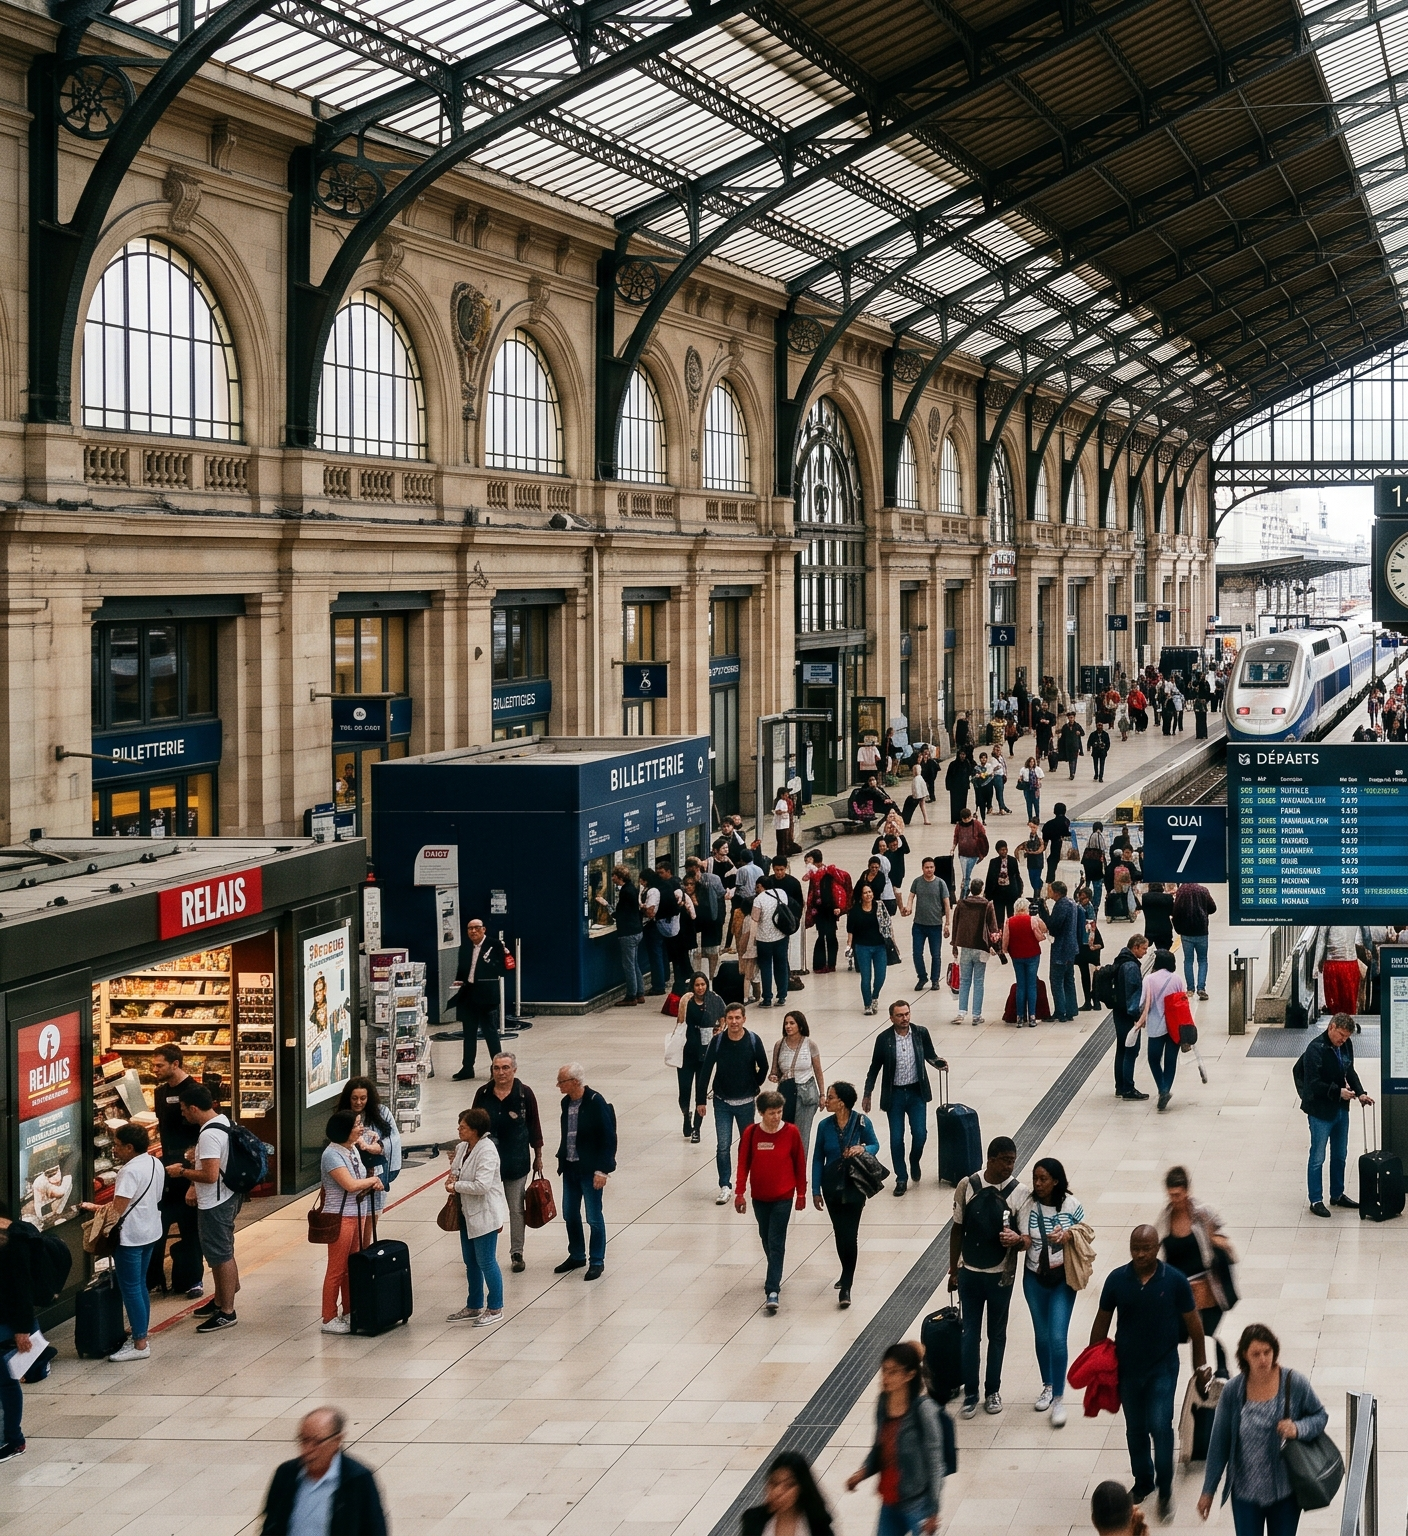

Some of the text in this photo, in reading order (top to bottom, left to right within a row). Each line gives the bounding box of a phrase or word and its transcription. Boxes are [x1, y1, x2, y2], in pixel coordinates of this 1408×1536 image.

[112, 739, 185, 763] BILLETTERIE
[610, 753, 684, 791] BILLETTERIE
[1167, 815, 1202, 826] QUAI
[1171, 834, 1198, 873] 7
[181, 877, 247, 928] RELAIS
